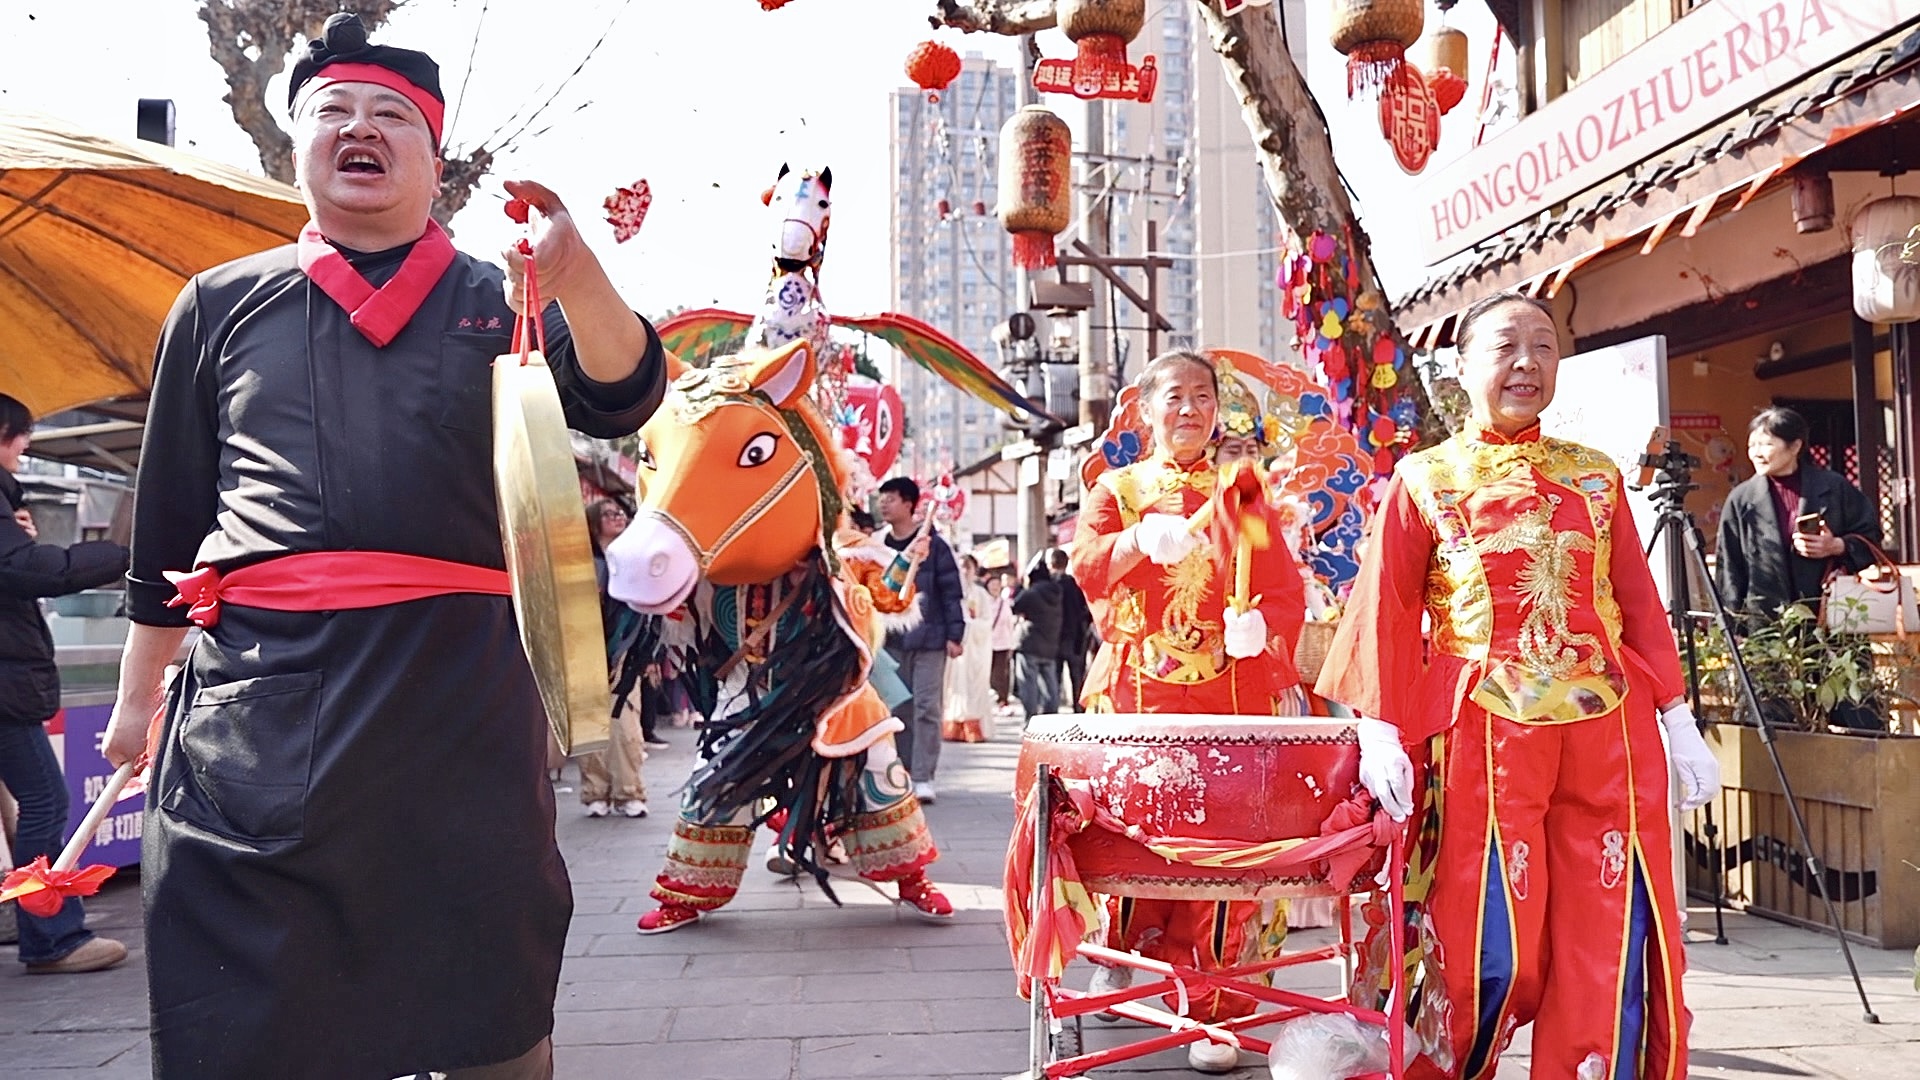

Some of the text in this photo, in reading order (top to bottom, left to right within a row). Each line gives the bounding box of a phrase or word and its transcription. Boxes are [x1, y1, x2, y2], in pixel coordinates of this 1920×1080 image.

[1392, 86, 1428, 156] 福
[1430, 0, 1836, 242] HONGQIAOZHUERBA
[83, 775, 113, 804] 奶
